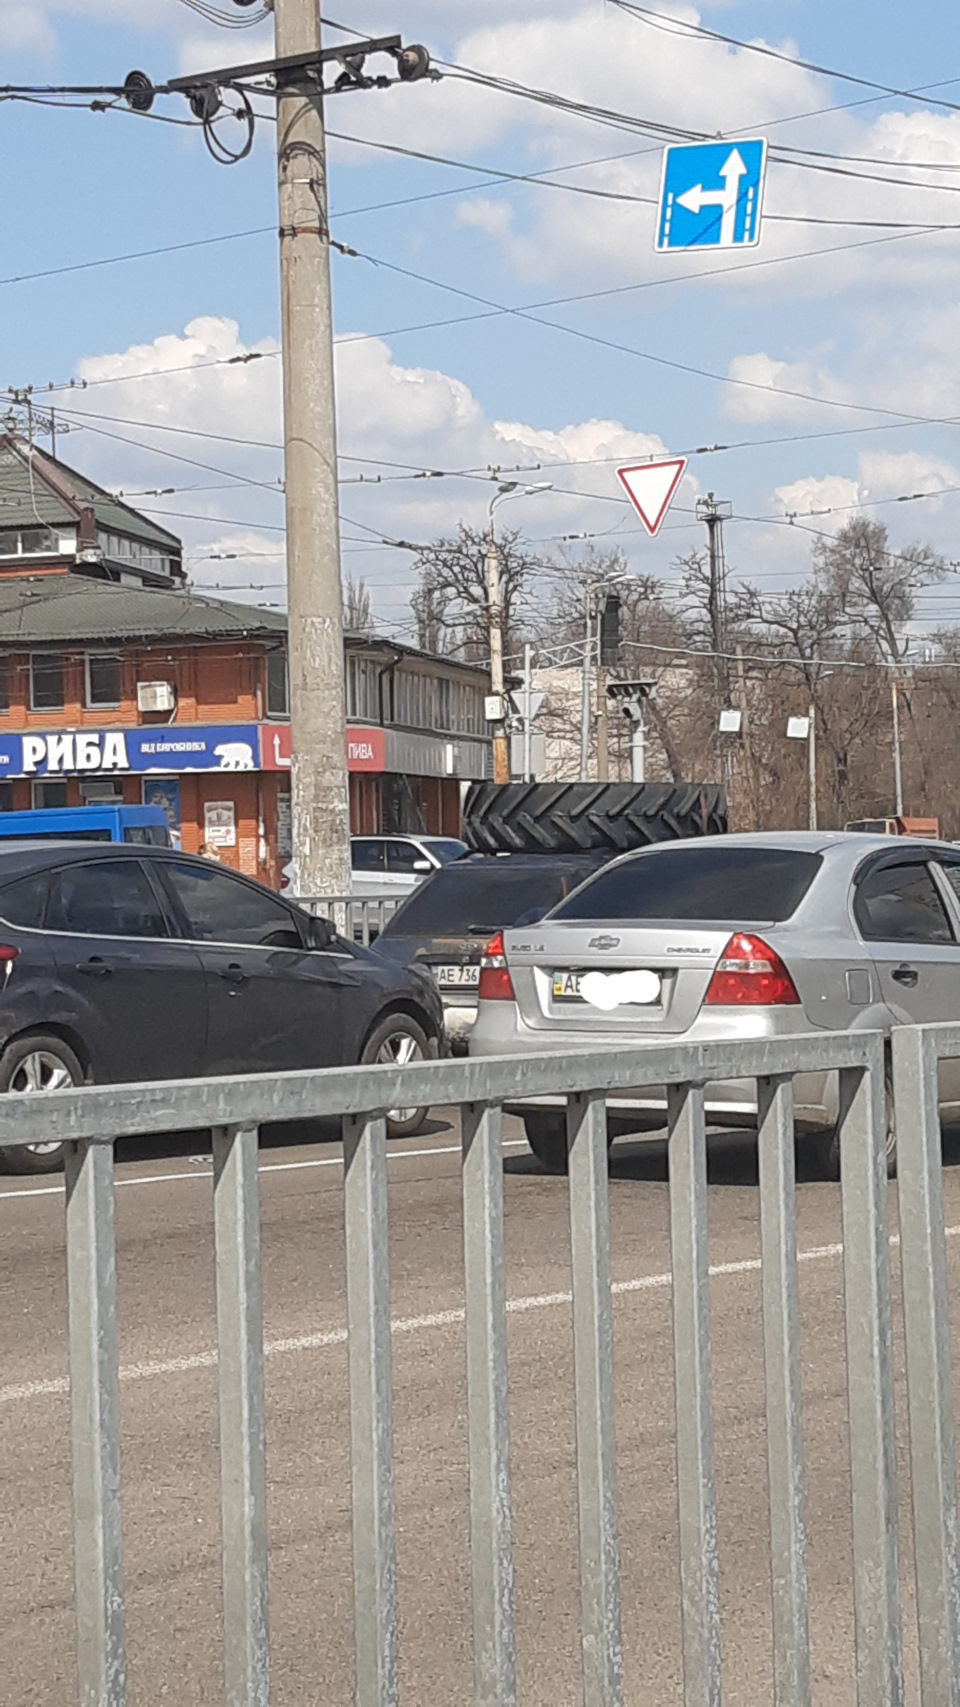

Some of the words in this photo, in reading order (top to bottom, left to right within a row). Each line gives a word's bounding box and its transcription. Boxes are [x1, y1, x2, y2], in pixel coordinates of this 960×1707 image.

[22, 732, 130, 773] РИБА
[347, 742, 374, 760] ПИВА
[439, 968, 455, 982] AE
